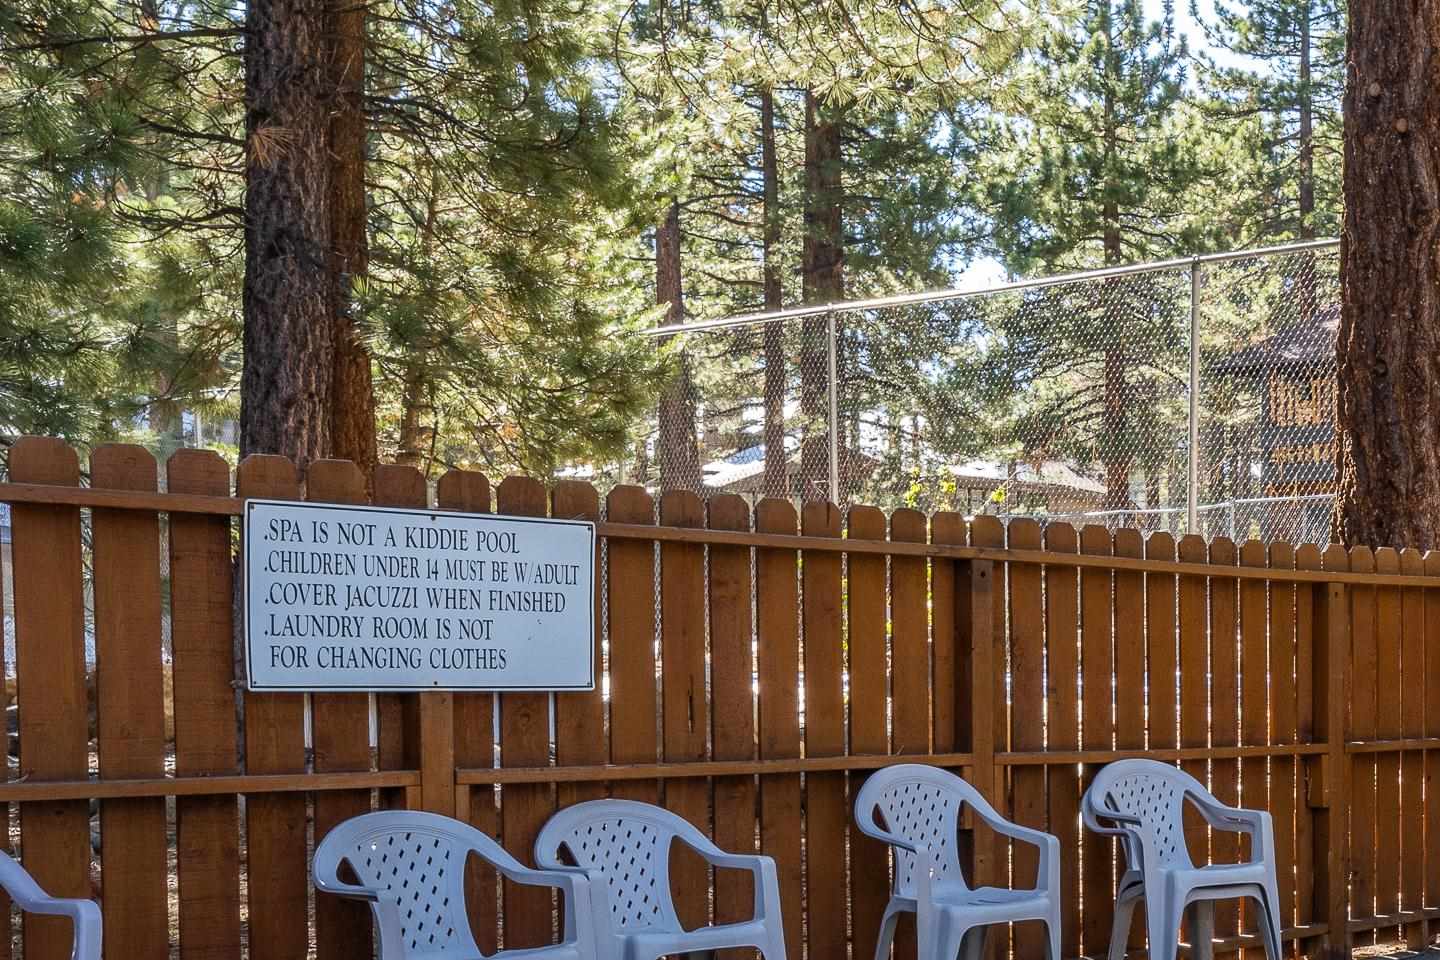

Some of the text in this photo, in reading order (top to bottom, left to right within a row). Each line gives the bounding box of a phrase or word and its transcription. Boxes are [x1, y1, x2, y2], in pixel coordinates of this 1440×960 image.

[313, 521, 328, 543] IS
[337, 523, 377, 547] NOT
[384, 527, 397, 547] A
[405, 526, 469, 551] KIDDIE
[477, 531, 520, 554] POOL
[364, 555, 419, 579] UNDER
[427, 559, 438, 581] 14
[446, 559, 485, 582] MUST
[492, 562, 509, 582] BE
[514, 562, 579, 585] W/ADULT
[345, 585, 418, 610] JACUZZI
[426, 587, 481, 610] WHEN
[489, 591, 566, 613] FINISHED
[373, 617, 427, 640] ROOM
[437, 619, 450, 639] IS
[459, 619, 493, 640] NOT
[270, 646, 507, 670] FOR CHANGING CLOTHES
